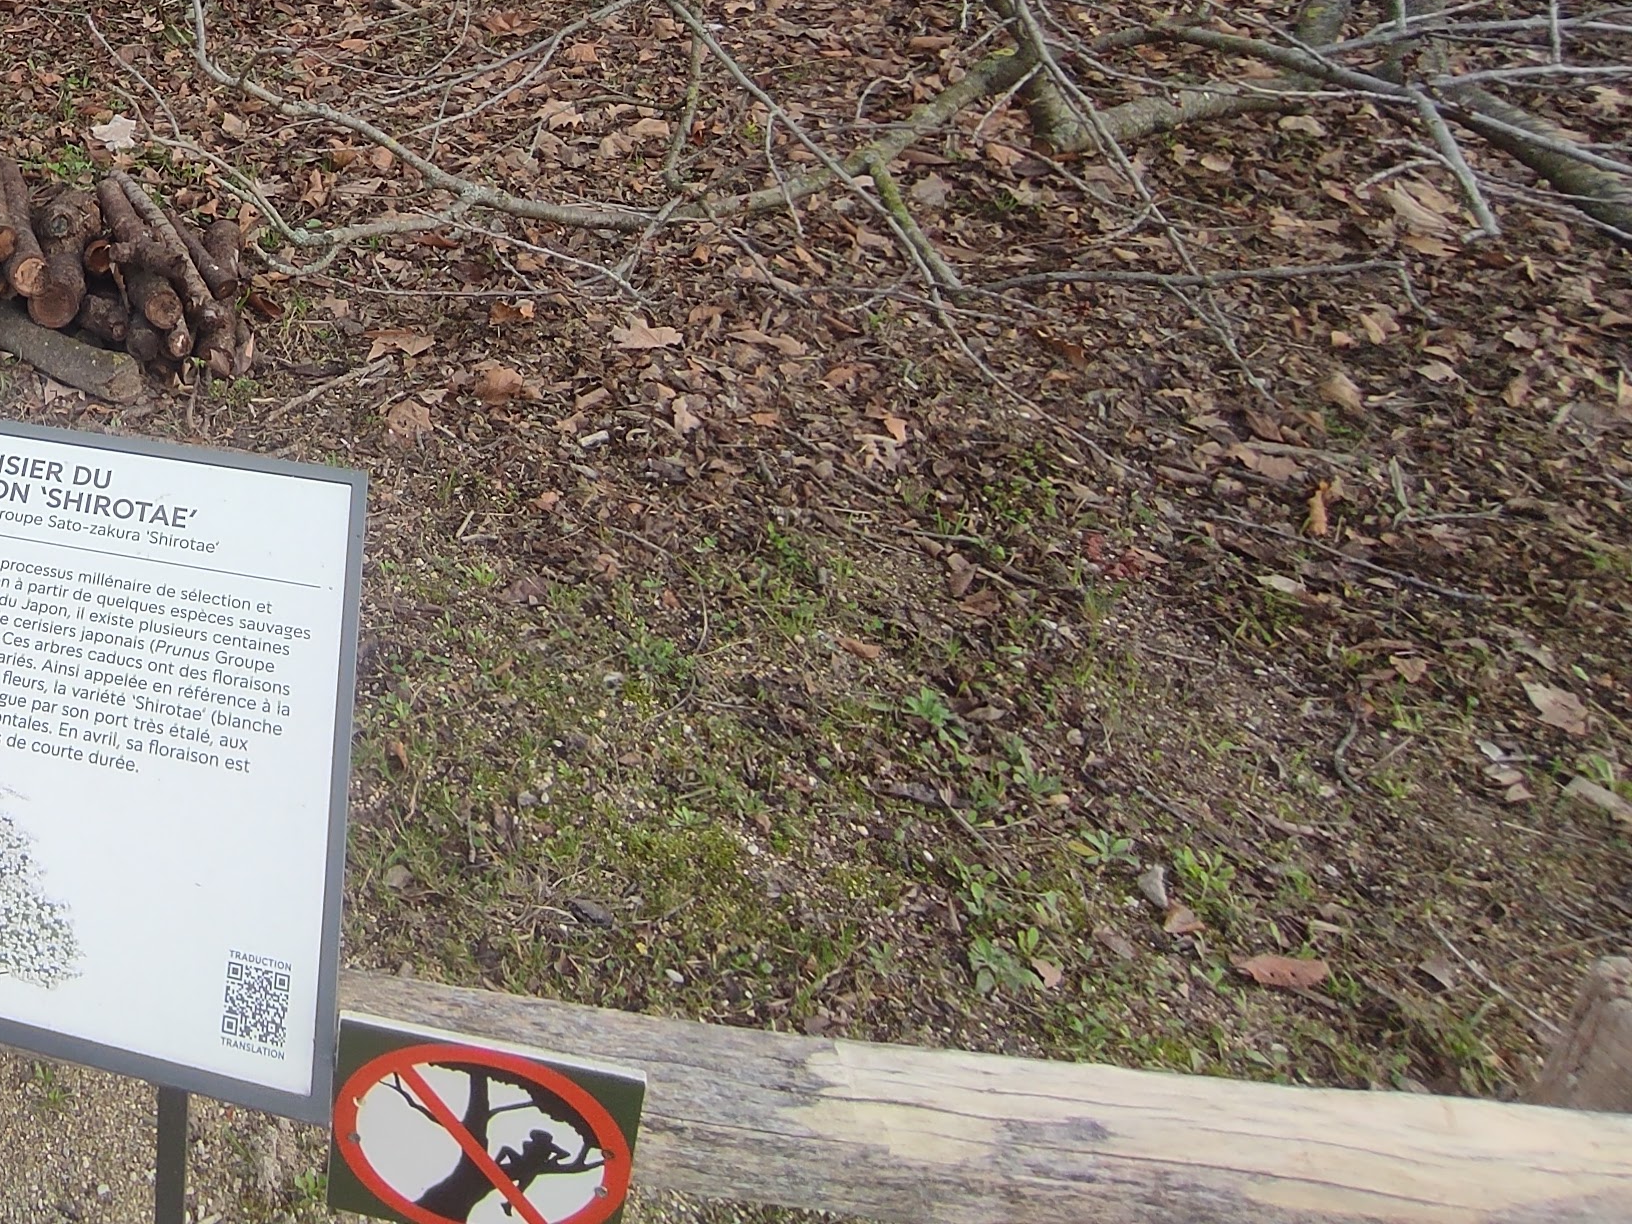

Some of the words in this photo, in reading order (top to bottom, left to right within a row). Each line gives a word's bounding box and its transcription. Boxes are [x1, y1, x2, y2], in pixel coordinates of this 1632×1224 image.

[71, 464, 112, 489] DU
[47, 514, 140, 541] Sato-zakura
[0, 559, 73, 581] processus
[77, 571, 151, 594] millénaire
[155, 582, 176, 598] de
[179, 587, 251, 611] sélection
[255, 601, 272, 615] et
[13, 576, 23, 590] à
[26, 581, 69, 598] partir
[71, 587, 92, 602] de
[95, 593, 165, 615] quelques
[169, 606, 234, 627] espèces
[238, 618, 311, 640] sauvages
[12, 616, 76, 638] cerisiers
[78, 625, 145, 650] japonais
[148, 638, 210, 662] (Prunus
[214, 649, 275, 673] Groupe
[20, 597, 71, 620] Japon,
[75, 605, 85, 620] il
[88, 611, 134, 629] existe
[137, 618, 208, 642] plusieurs
[212, 632, 290, 656] centaines
[1, 630, 30, 649] Ces
[33, 639, 83, 658] arbres
[86, 649, 143, 669] caducs
[147, 660, 175, 675] ont
[178, 663, 207, 681] des
[212, 668, 290, 696] floraisons
[40, 658, 80, 678] Ainsi
[83, 668, 147, 690] appelée
[151, 681, 172, 695] en
[177, 684, 257, 710] référence
[261, 697, 271, 713] à
[276, 700, 290, 717] la
[1, 669, 48, 694] fleurs,
[52, 679, 66, 695] la
[71, 686, 126, 706] variété
[210, 709, 282, 736] (blanche
[30, 698, 58, 714] par
[60, 704, 89, 720] son
[93, 710, 128, 728] port
[133, 716, 164, 735] très
[168, 722, 213, 747] étalé,
[218, 734, 248, 751] aux
[5, 732, 26, 750] de
[30, 740, 83, 761] courte
[87, 749, 139, 773] durée.
[57, 721, 78, 739] En
[82, 729, 120, 750] avril,
[125, 738, 143, 752] sa
[148, 738, 219, 767] floraison
[224, 757, 250, 773] est
[229, 949, 291, 972] TRADUCTION
[220, 1035, 284, 1060] TRANSLATION
